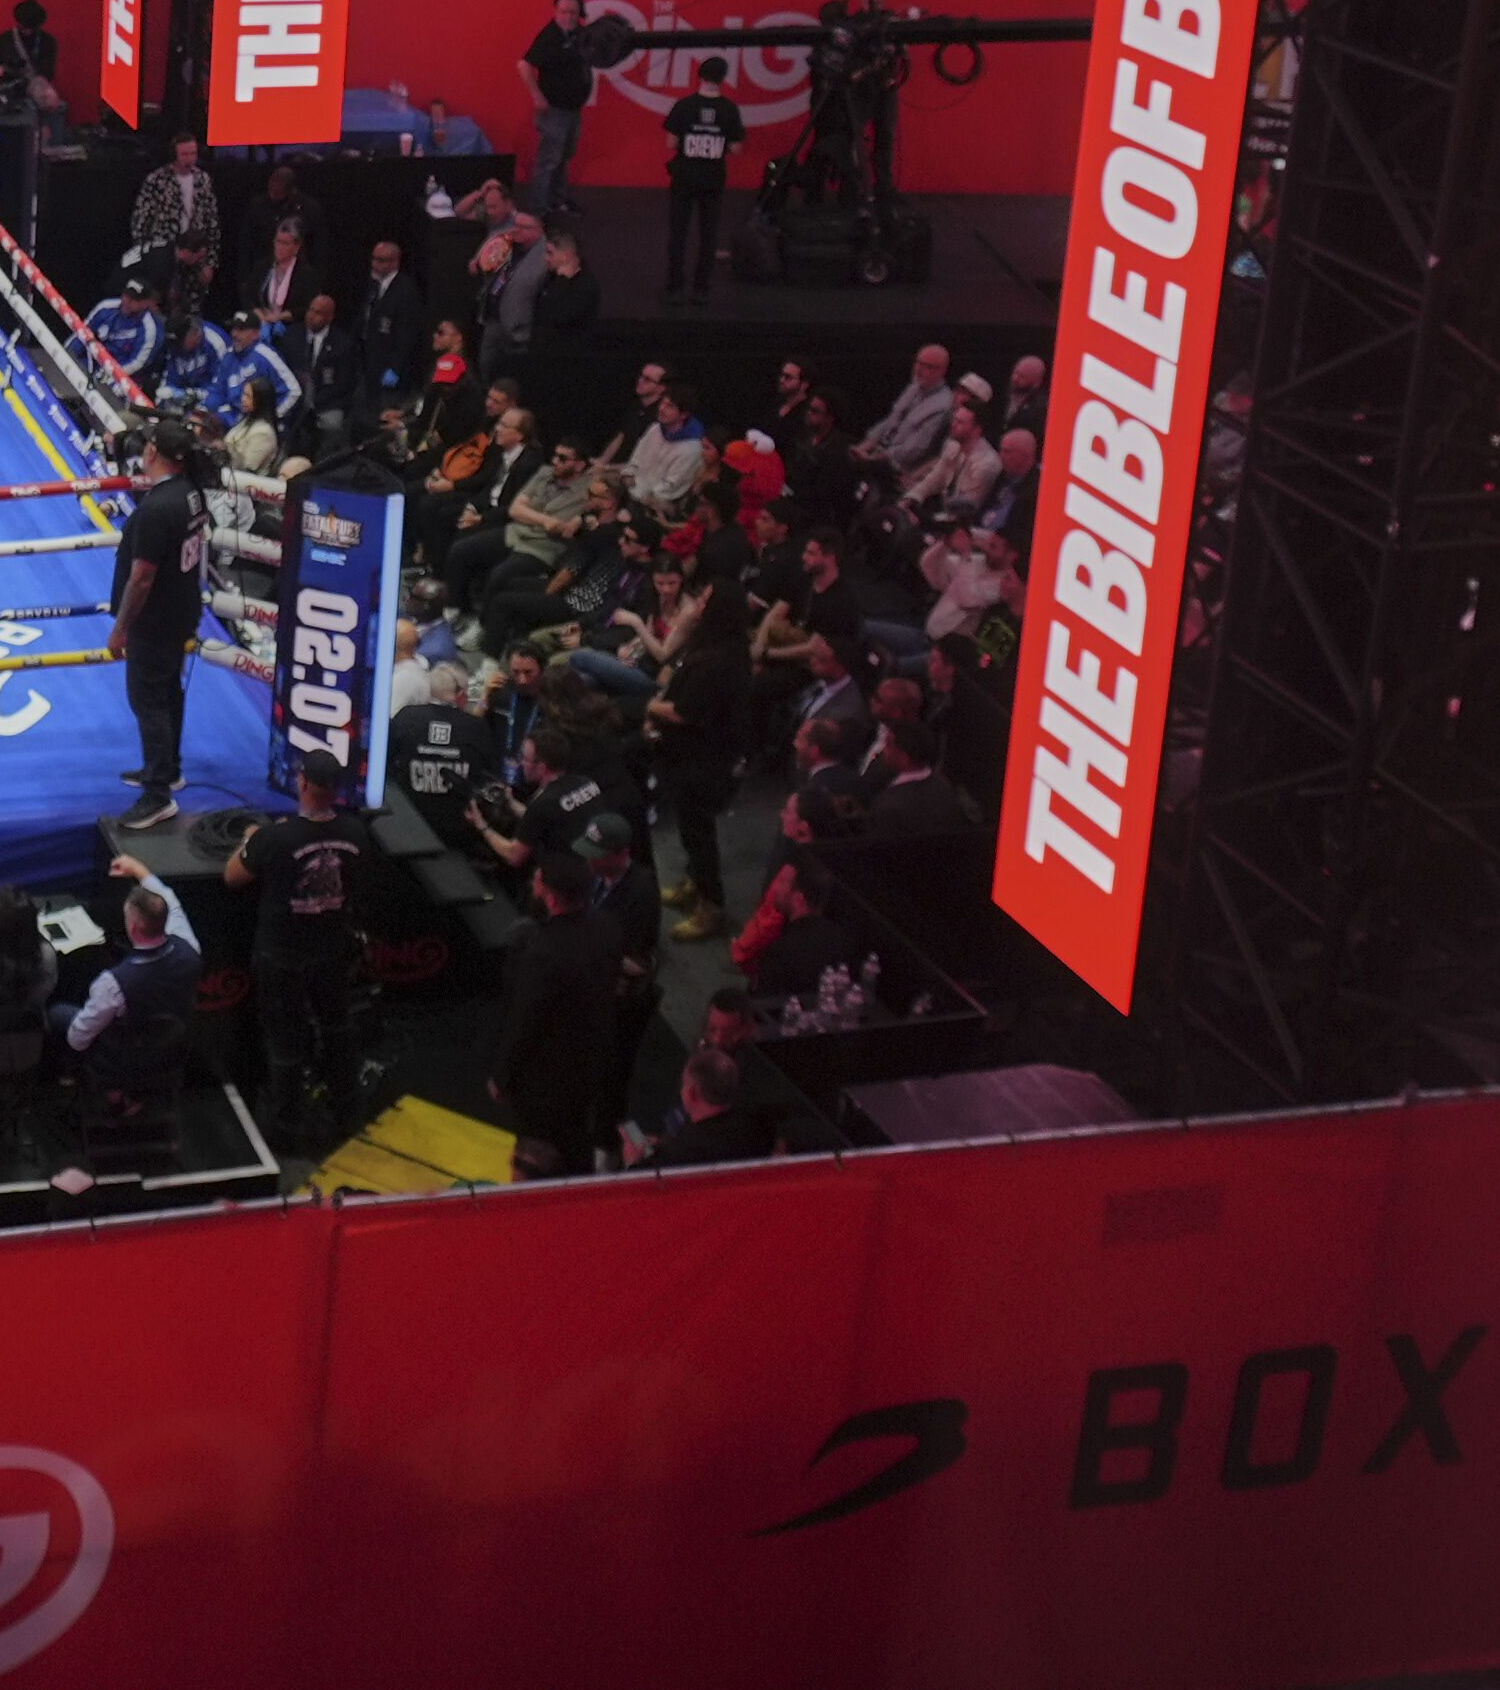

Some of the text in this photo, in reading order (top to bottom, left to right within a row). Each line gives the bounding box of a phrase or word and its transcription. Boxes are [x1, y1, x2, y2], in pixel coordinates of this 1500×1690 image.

[684, 133, 726, 160] CREW
[1102, 59, 1206, 258] OF
[1056, 247, 1186, 656] BIBLE
[288, 587, 359, 767] 02:07
[1026, 621, 1137, 893] THE
[559, 780, 602, 811] CREW
